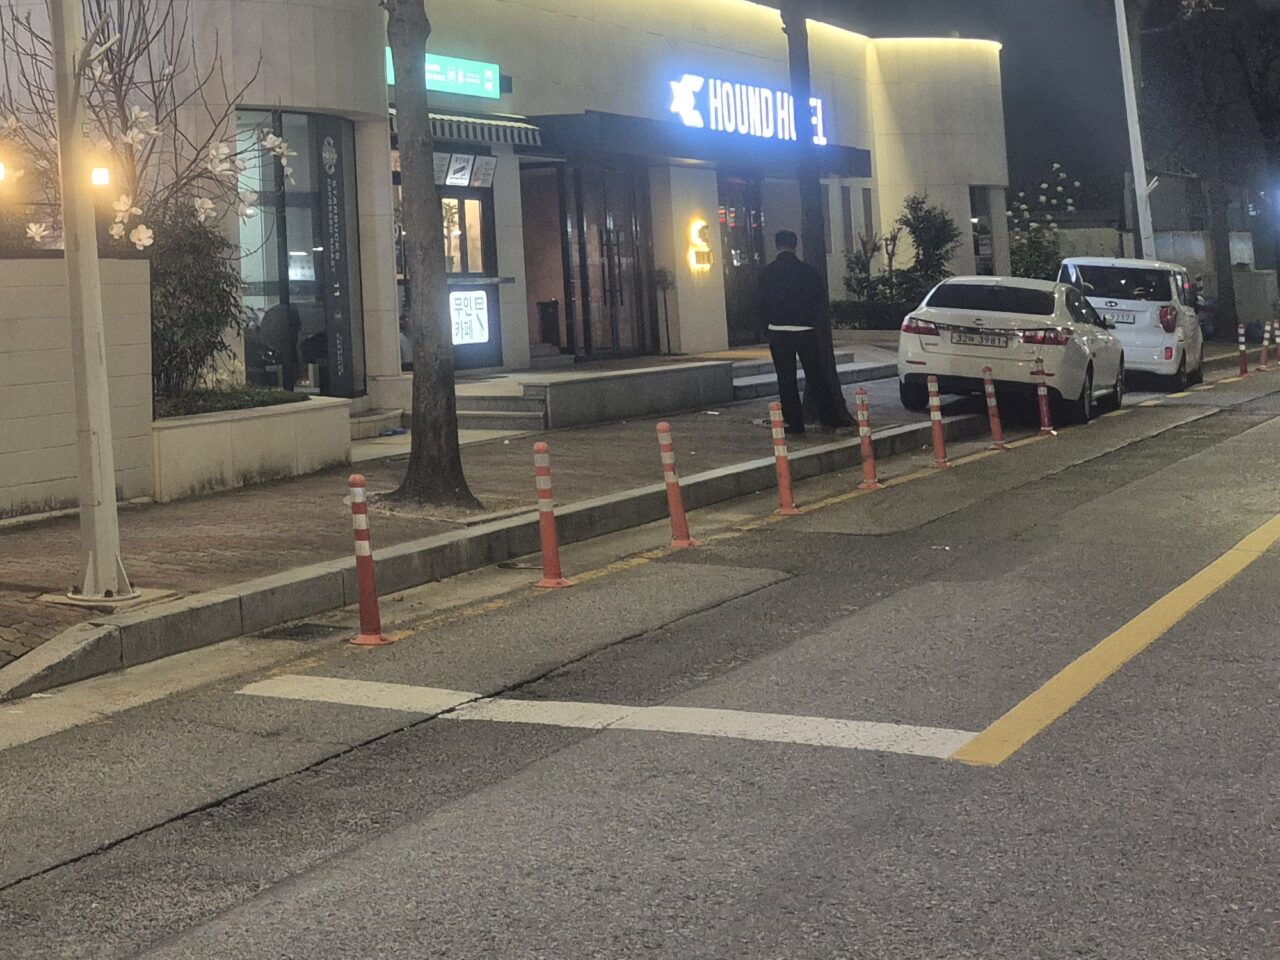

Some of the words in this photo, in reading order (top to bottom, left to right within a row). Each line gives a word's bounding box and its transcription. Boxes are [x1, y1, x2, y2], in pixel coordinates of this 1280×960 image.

[708, 78, 774, 138] HOUND
[331, 180, 340, 260] STARBUCKS
[454, 296, 472, 317] 무인
[455, 319, 473, 340] 카페
